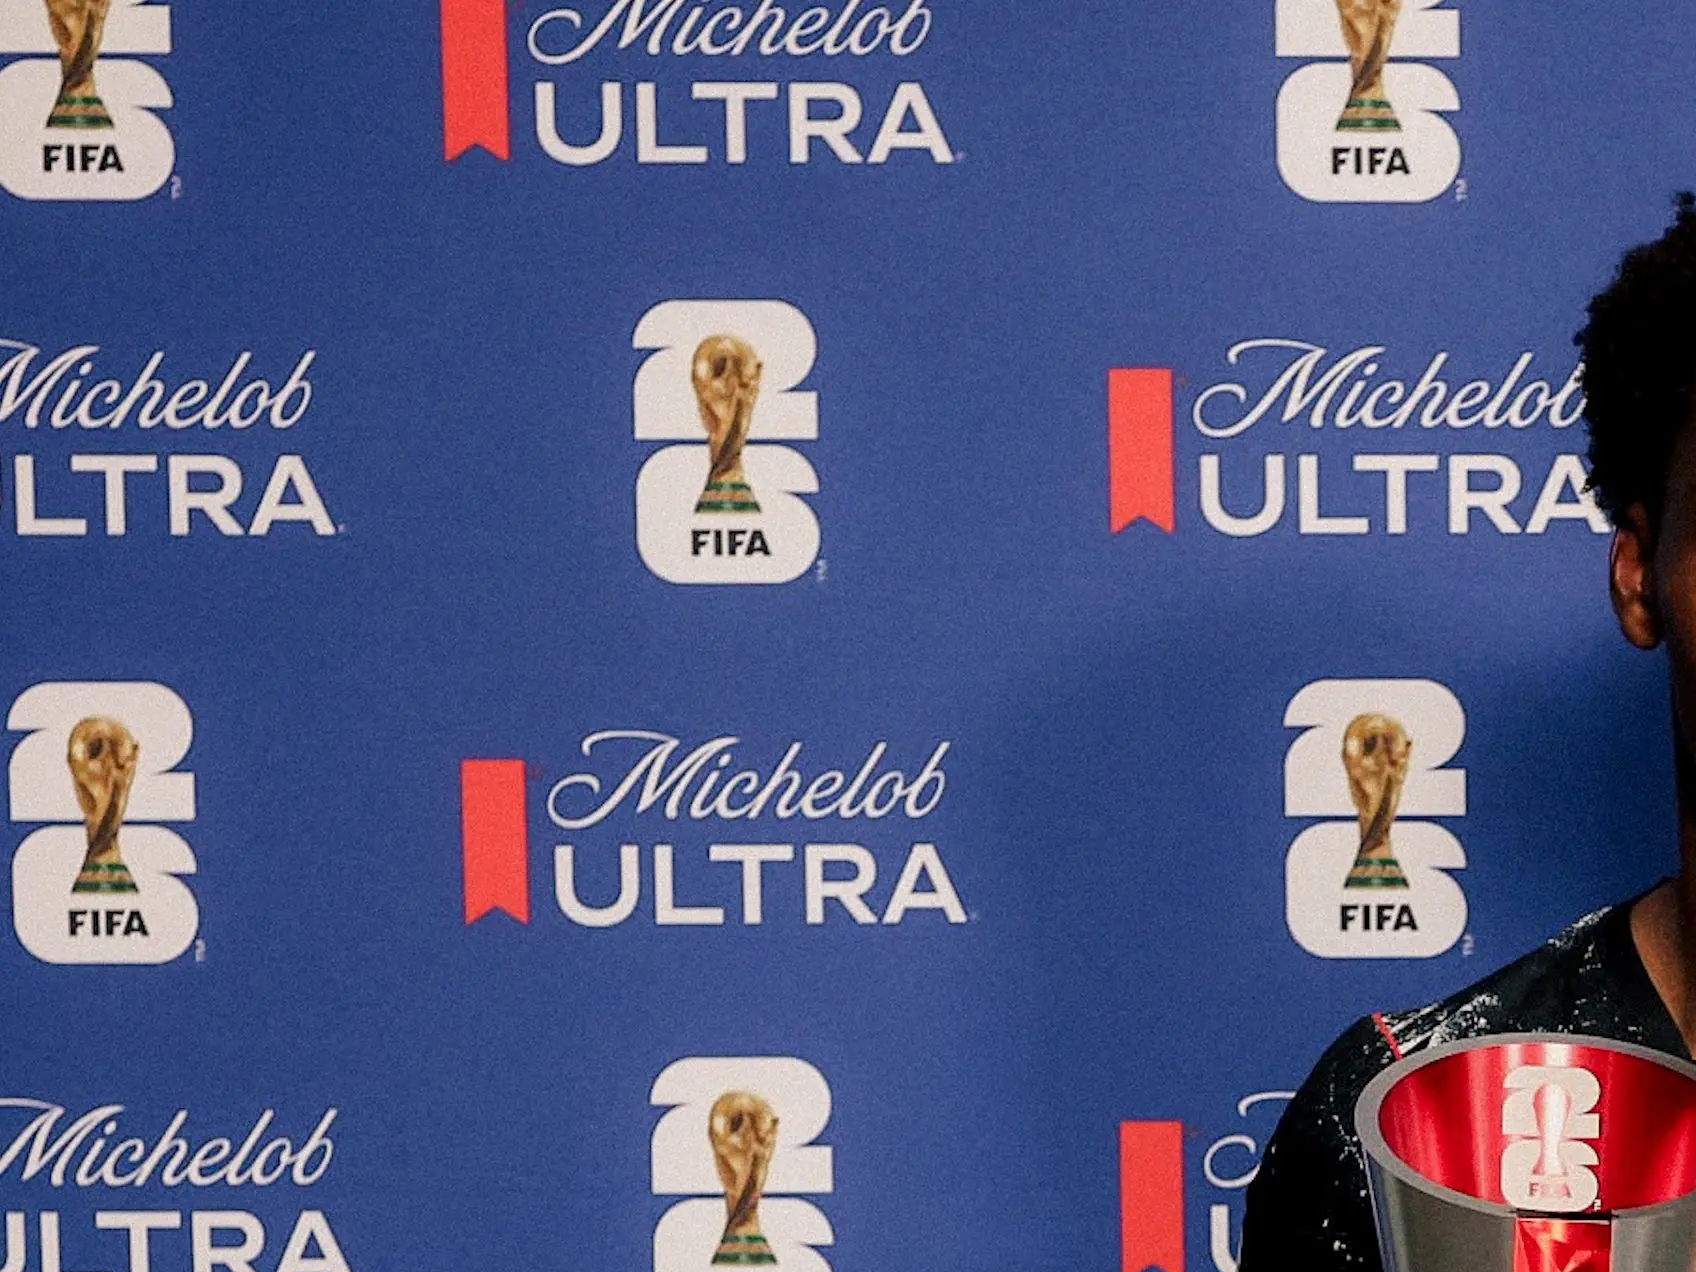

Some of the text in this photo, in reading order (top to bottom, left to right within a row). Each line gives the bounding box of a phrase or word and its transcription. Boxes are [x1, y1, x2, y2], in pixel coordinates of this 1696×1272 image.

[528, 0, 931, 64] Michelob
[535, 82, 953, 165] ULTRA
[43, 144, 124, 172] FIFA
[1332, 147, 1410, 175] FIFA
[15, 455, 335, 535] LTRA
[1200, 454, 1611, 536] ULTRA
[691, 529, 771, 556] FIFA
[547, 730, 950, 829] Michelob
[554, 844, 967, 927] ULTRA
[1340, 904, 1418, 931] FIFA
[68, 910, 149, 937] FIFA
